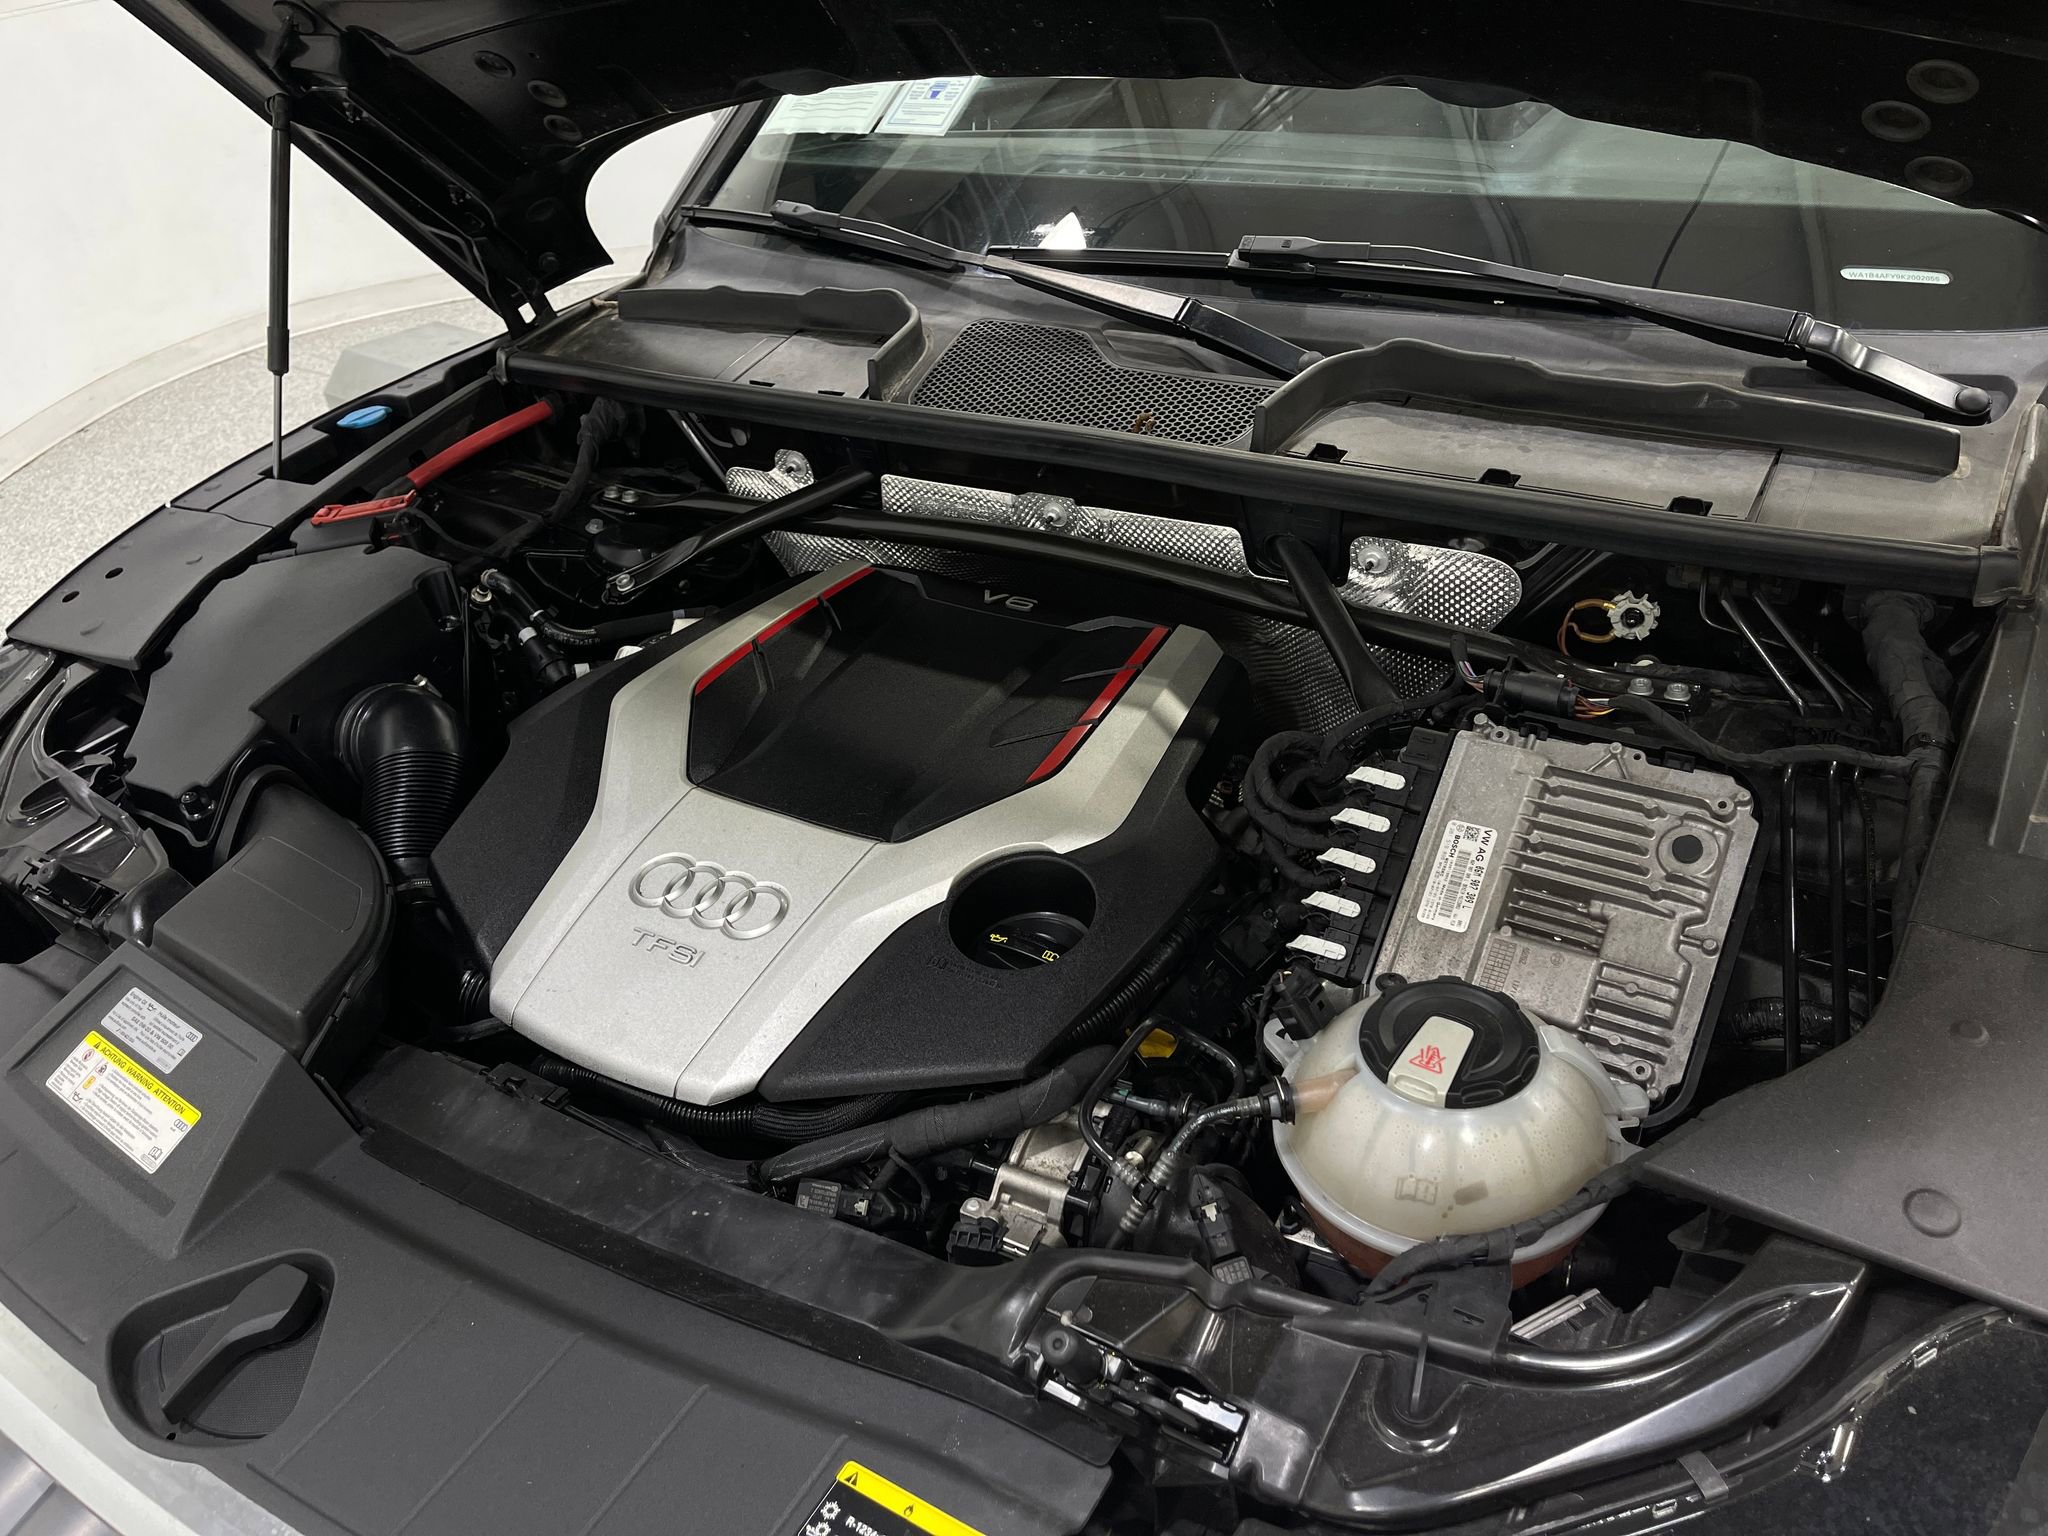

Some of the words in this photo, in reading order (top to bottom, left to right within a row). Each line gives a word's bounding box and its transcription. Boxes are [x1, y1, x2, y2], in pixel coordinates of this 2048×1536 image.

[984, 589, 1038, 612] V6
[1448, 834, 1461, 858] BOSCH
[1481, 829, 1493, 846] VW
[1475, 847, 1486, 862] AG
[631, 927, 706, 968] TFSI
[100, 1047, 126, 1068] ACHTUNG
[126, 1065, 154, 1090] WARNING
[153, 1088, 185, 1114] ATTENTION
